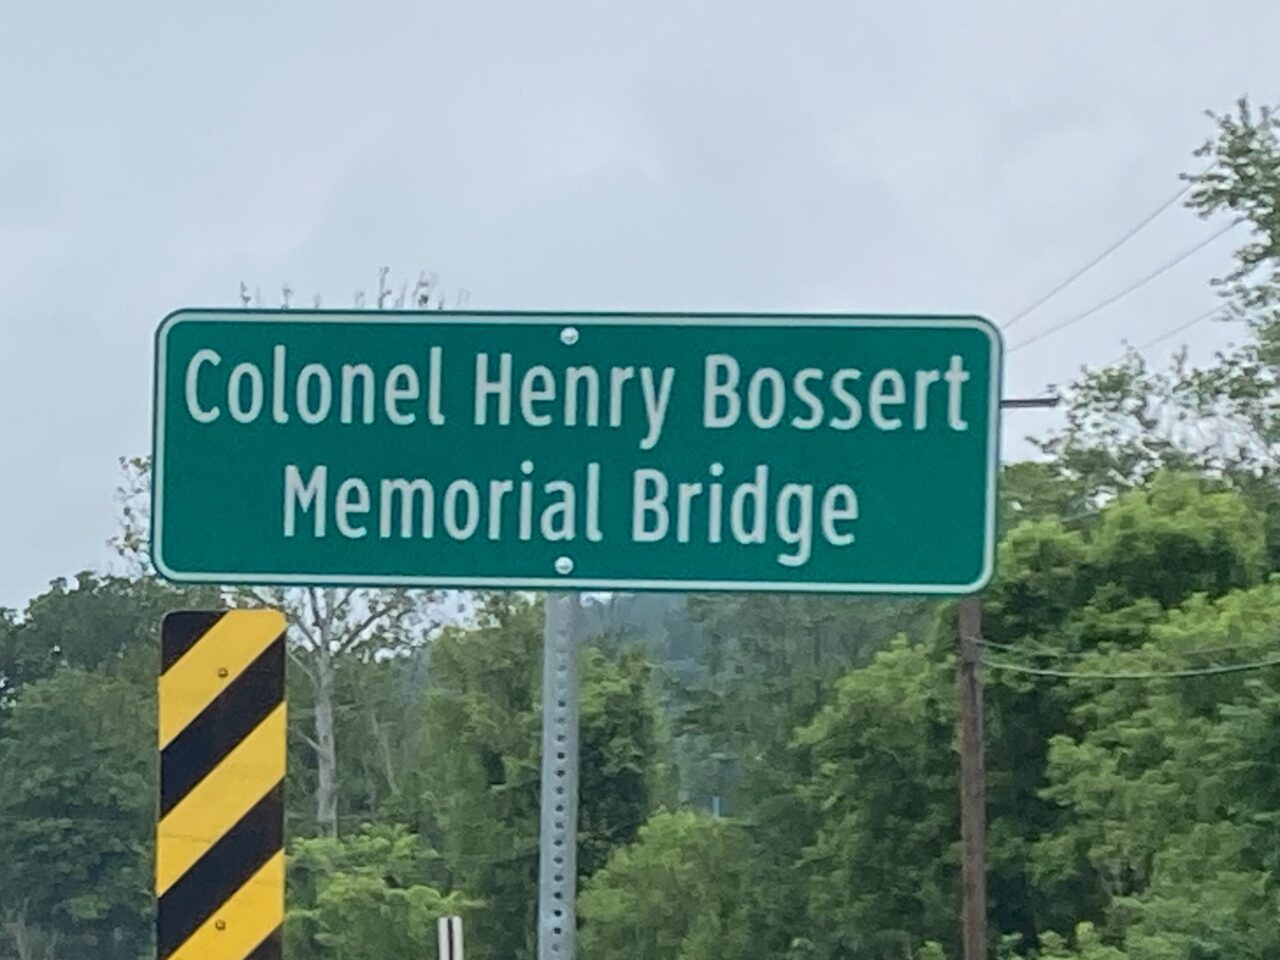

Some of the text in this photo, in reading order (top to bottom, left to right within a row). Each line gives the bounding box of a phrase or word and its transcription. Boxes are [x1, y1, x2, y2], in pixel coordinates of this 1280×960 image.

[185, 344, 970, 451] Colonel Henry Bossert
[283, 459, 859, 567] Memorial Bridge
